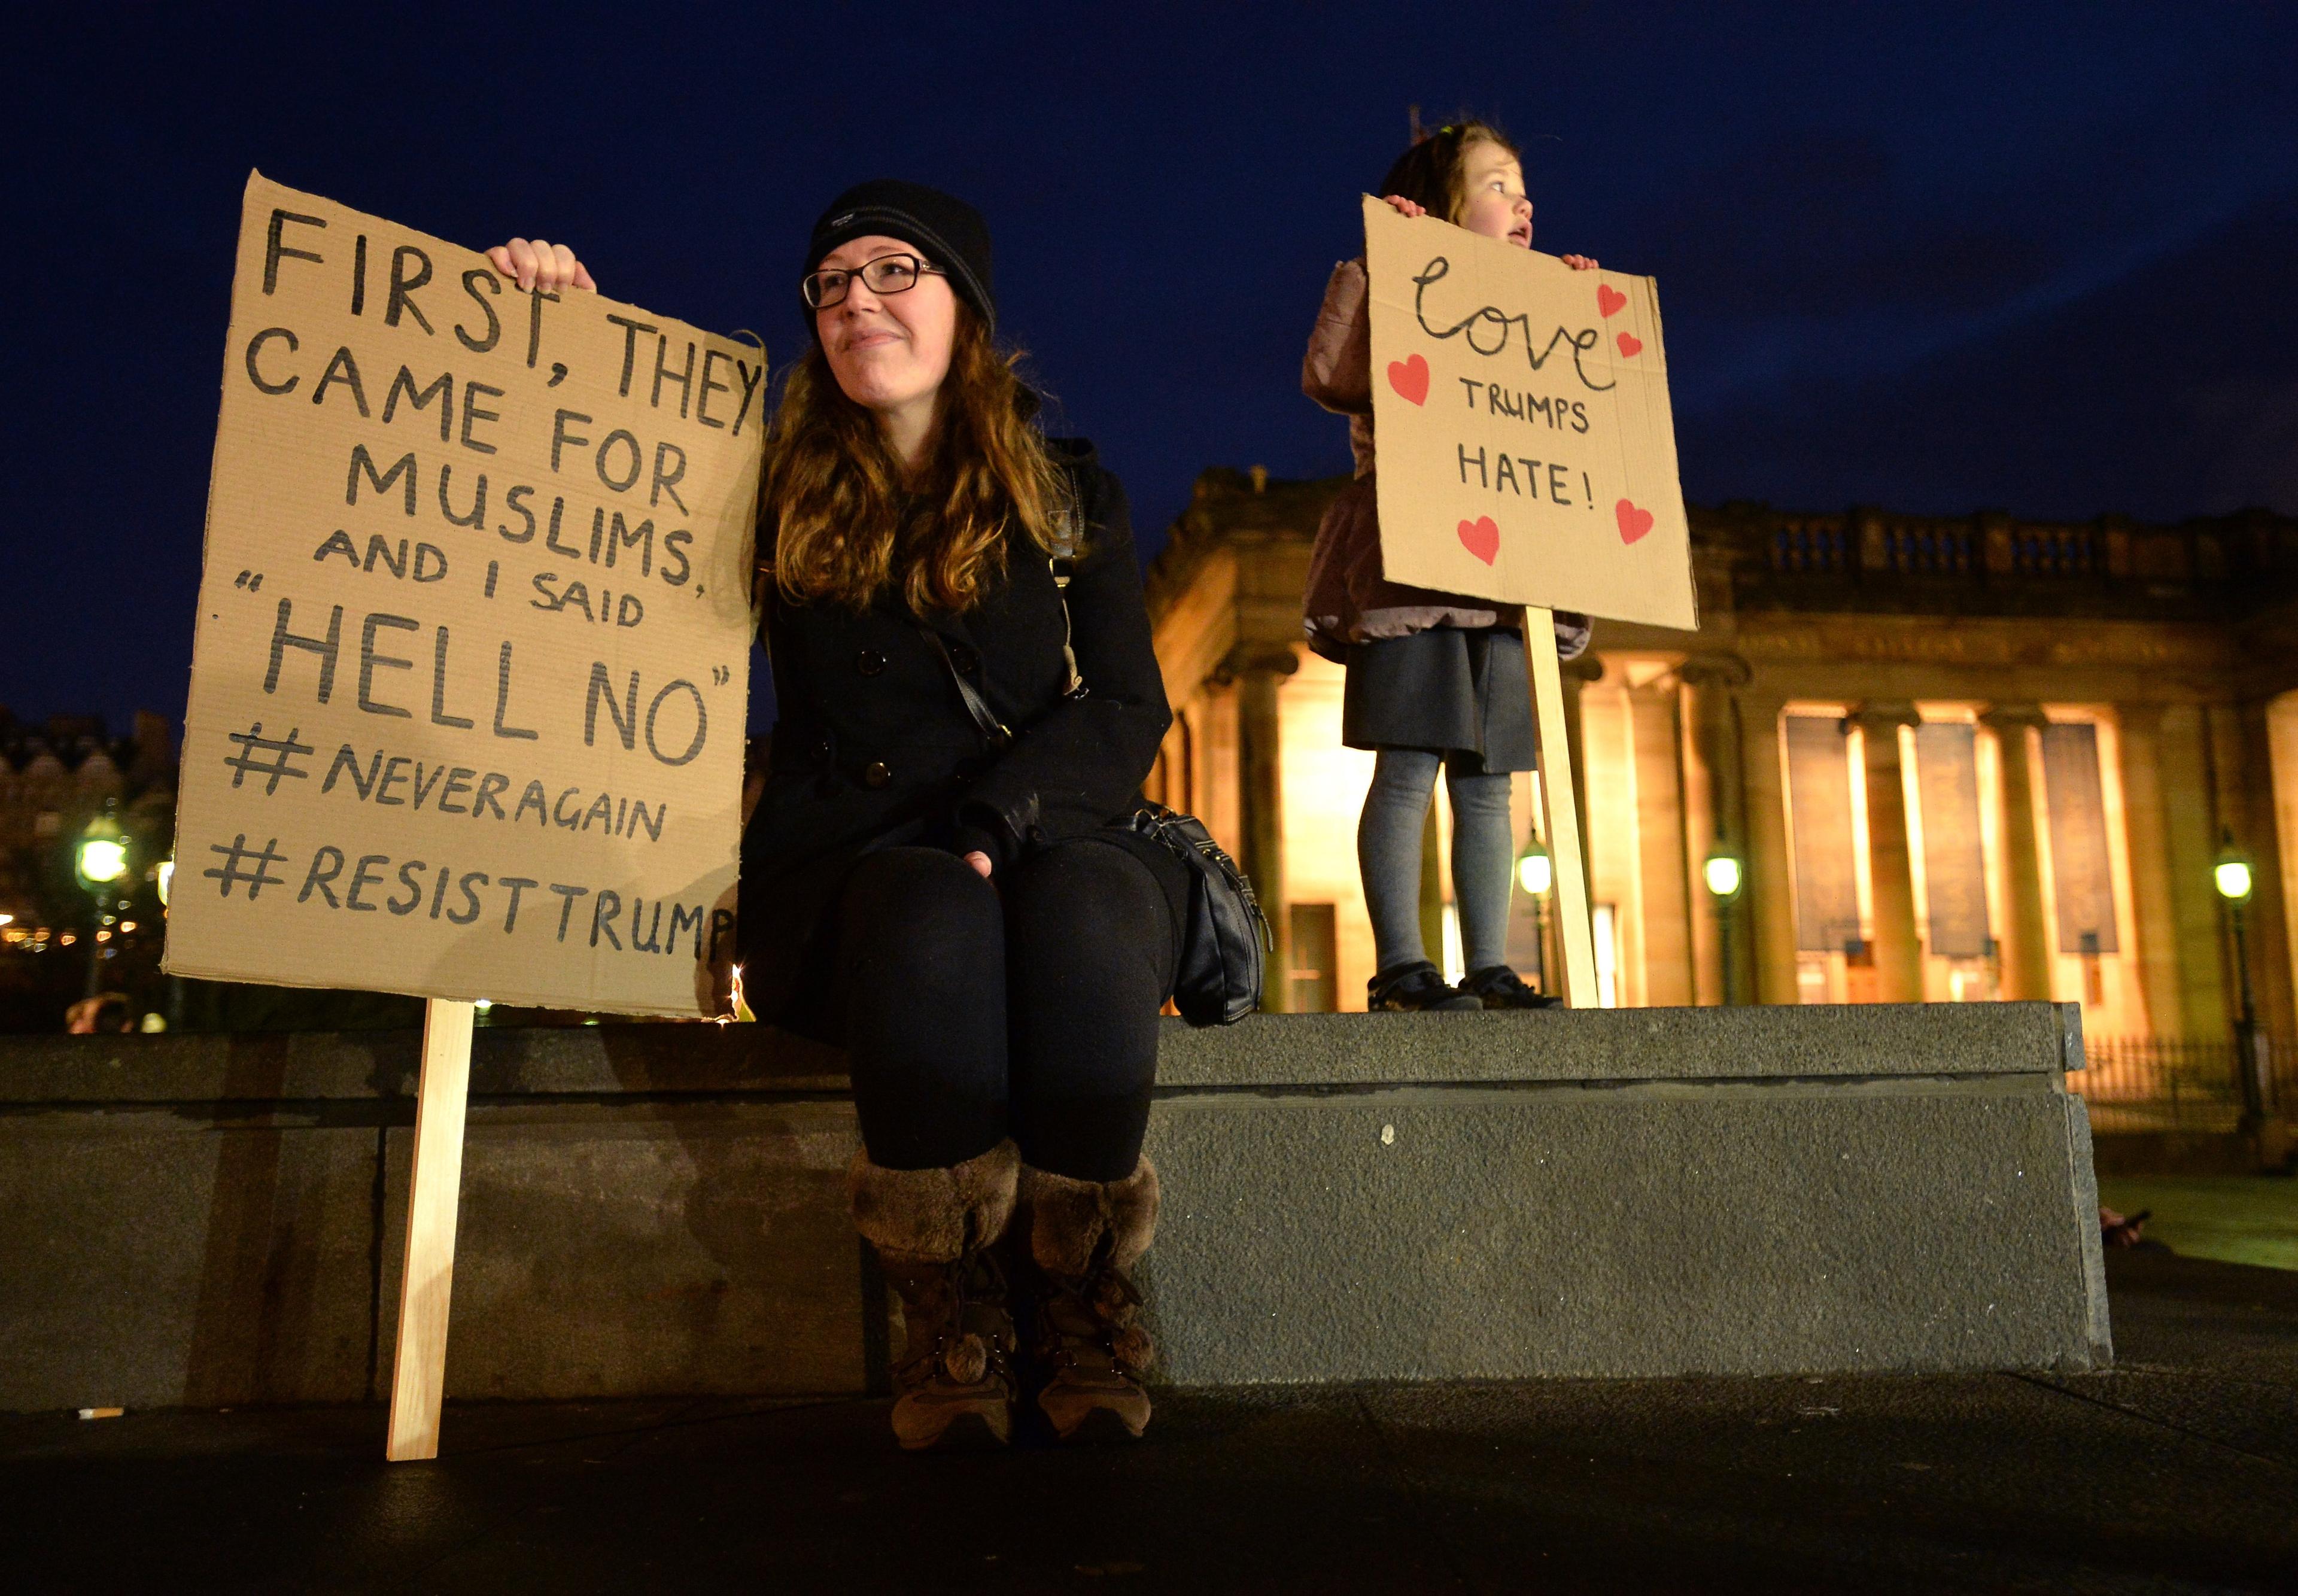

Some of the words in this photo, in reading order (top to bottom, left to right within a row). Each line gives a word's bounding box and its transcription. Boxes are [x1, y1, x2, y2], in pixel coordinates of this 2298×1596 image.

[263, 209, 569, 387] FIRST,
[607, 314, 762, 436] THEY
[245, 327, 505, 455] CAME
[551, 409, 689, 516] FOR
[1459, 377, 1589, 433] TRUMPS
[346, 445, 705, 598] MUSLIMS,
[1458, 443, 1594, 510] HATE!
[314, 530, 448, 582] AND
[485, 561, 499, 598] I
[529, 572, 643, 628] SAID
[224, 722, 667, 843] #NEVERAGAIN
